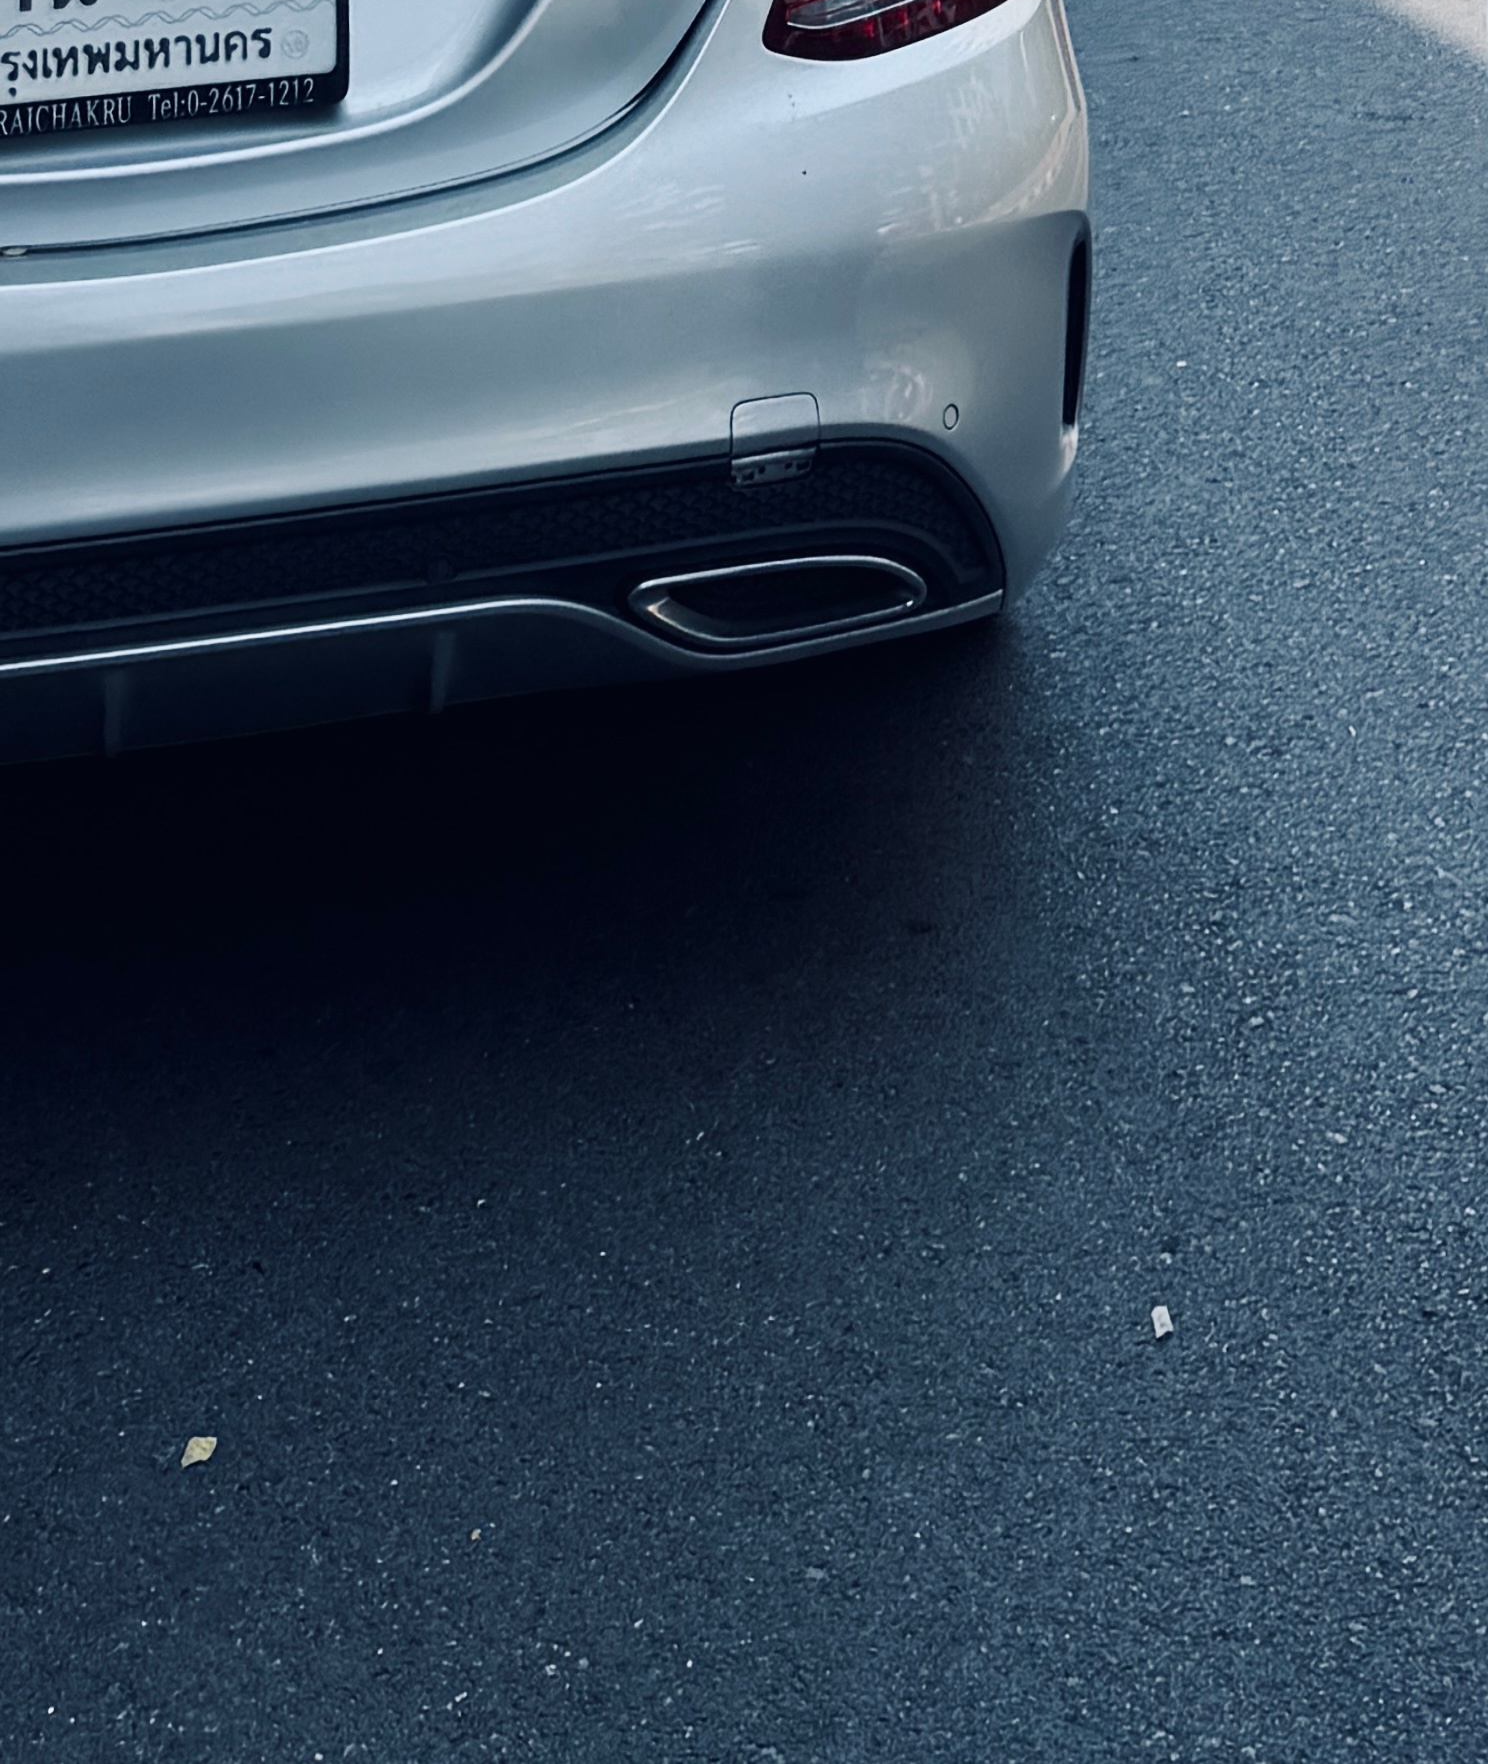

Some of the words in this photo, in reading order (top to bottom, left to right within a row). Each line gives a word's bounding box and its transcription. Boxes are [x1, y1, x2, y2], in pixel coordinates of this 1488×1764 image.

[0, 26, 274, 98] รุงเทพมหานคร
[147, 78, 315, 121] Tel:0-2617-1212
